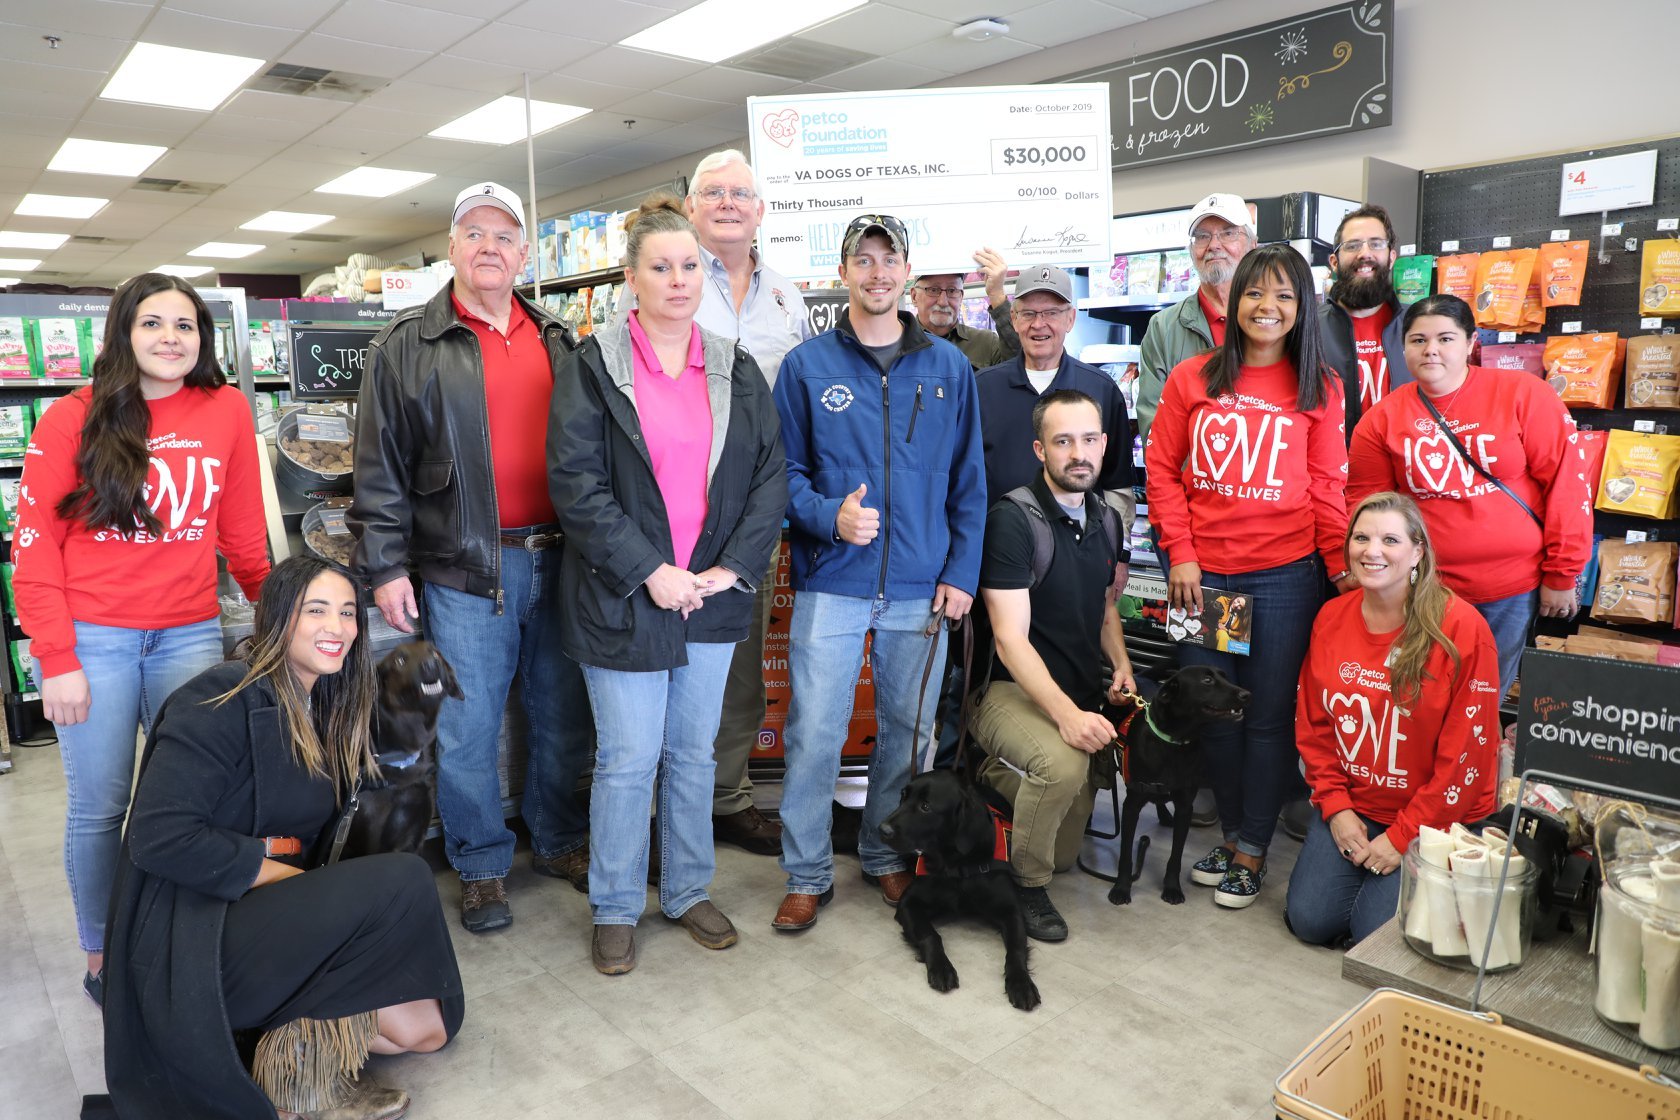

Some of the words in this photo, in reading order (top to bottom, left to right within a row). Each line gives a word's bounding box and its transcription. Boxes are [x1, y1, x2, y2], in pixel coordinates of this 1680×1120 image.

[1128, 53, 1249, 127] FOOD
[1009, 105, 1033, 114] Date:
[1035, 104, 1070, 112] October
[1072, 103, 1092, 111] 2019
[801, 111, 848, 127] petco
[802, 127, 888, 143] foundation
[1138, 122, 1210, 155] frozen
[1003, 146, 1086, 166] $30,000
[795, 170, 812, 180] VA
[816, 168, 852, 180] DOGS
[855, 167, 873, 177] OF
[876, 164, 921, 176] TEXAS,
[924, 164, 950, 174] INC.
[770, 200, 804, 210] Thirty
[807, 196, 864, 208] Thousand
[1018, 186, 1057, 198] 00/100
[1065, 192, 1100, 200] Dollars
[770, 236, 804, 244] memo:
[58, 303, 82, 312] daily
[358, 310, 376, 318] daily
[0, 342, 22, 351] uppy
[336, 349, 368, 370] TRE
[1236, 394, 1265, 406] petco
[1192, 408, 1293, 486] LOVE
[1193, 478, 1234, 496] SAVES
[1238, 486, 1282, 502] LIVES
[1142, 584, 1149, 592] is
[1150, 586, 1168, 595] Mad
[766, 642, 790, 652] nstag
[1359, 668, 1386, 680] petco
[1572, 696, 1680, 735] shoppin
[1529, 722, 1680, 765] convenienc
[1370, 772, 1408, 789] IVES
